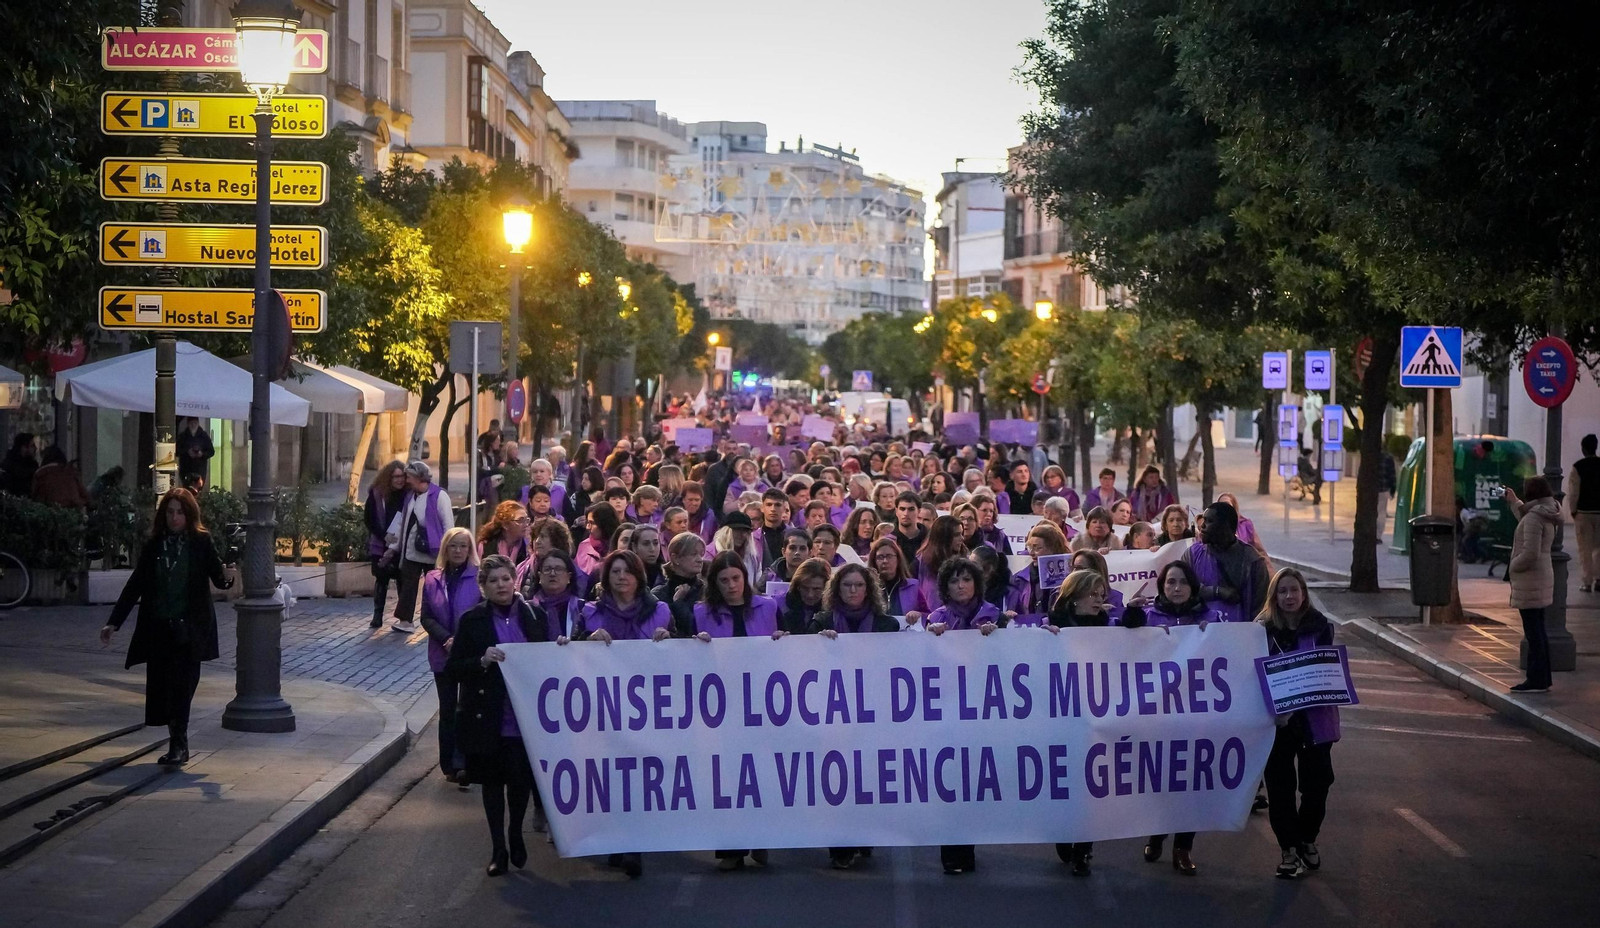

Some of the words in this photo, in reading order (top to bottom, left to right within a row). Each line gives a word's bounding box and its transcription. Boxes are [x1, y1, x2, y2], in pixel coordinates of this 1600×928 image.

[110, 40, 197, 59] ALCÁZAR
[204, 36, 238, 48] Cáma
[204, 52, 238, 64] Oscu
[274, 103, 299, 113] otel
[229, 115, 246, 129] El
[272, 117, 319, 130] oloso
[250, 168, 284, 178] hel
[171, 178, 212, 193] Asta
[218, 180, 256, 196] Regi
[273, 181, 317, 195] Jerez
[270, 233, 303, 244] hotel
[200, 246, 256, 261] Nuevo
[270, 247, 316, 261] Hotel
[165, 310, 219, 325] Hostal
[1109, 570, 1158, 583] ONTRA
[1266, 658, 1295, 668] MERCEDES
[1296, 653, 1318, 662] RAPOSO
[537, 673, 727, 734] CONSEJO
[742, 668, 876, 728] LOCAL
[889, 666, 943, 723] DE
[957, 663, 1033, 721] LAS
[1048, 656, 1233, 719] MUJERES
[1275, 700, 1292, 710] STOP
[1291, 694, 1322, 705] VIOLENCIA
[540, 755, 697, 816] ONTRA
[711, 753, 763, 810] LA
[774, 746, 1003, 808] VIOLENCIA
[1016, 744, 1070, 801] DE
[1084, 735, 1247, 799] GÉNERO
